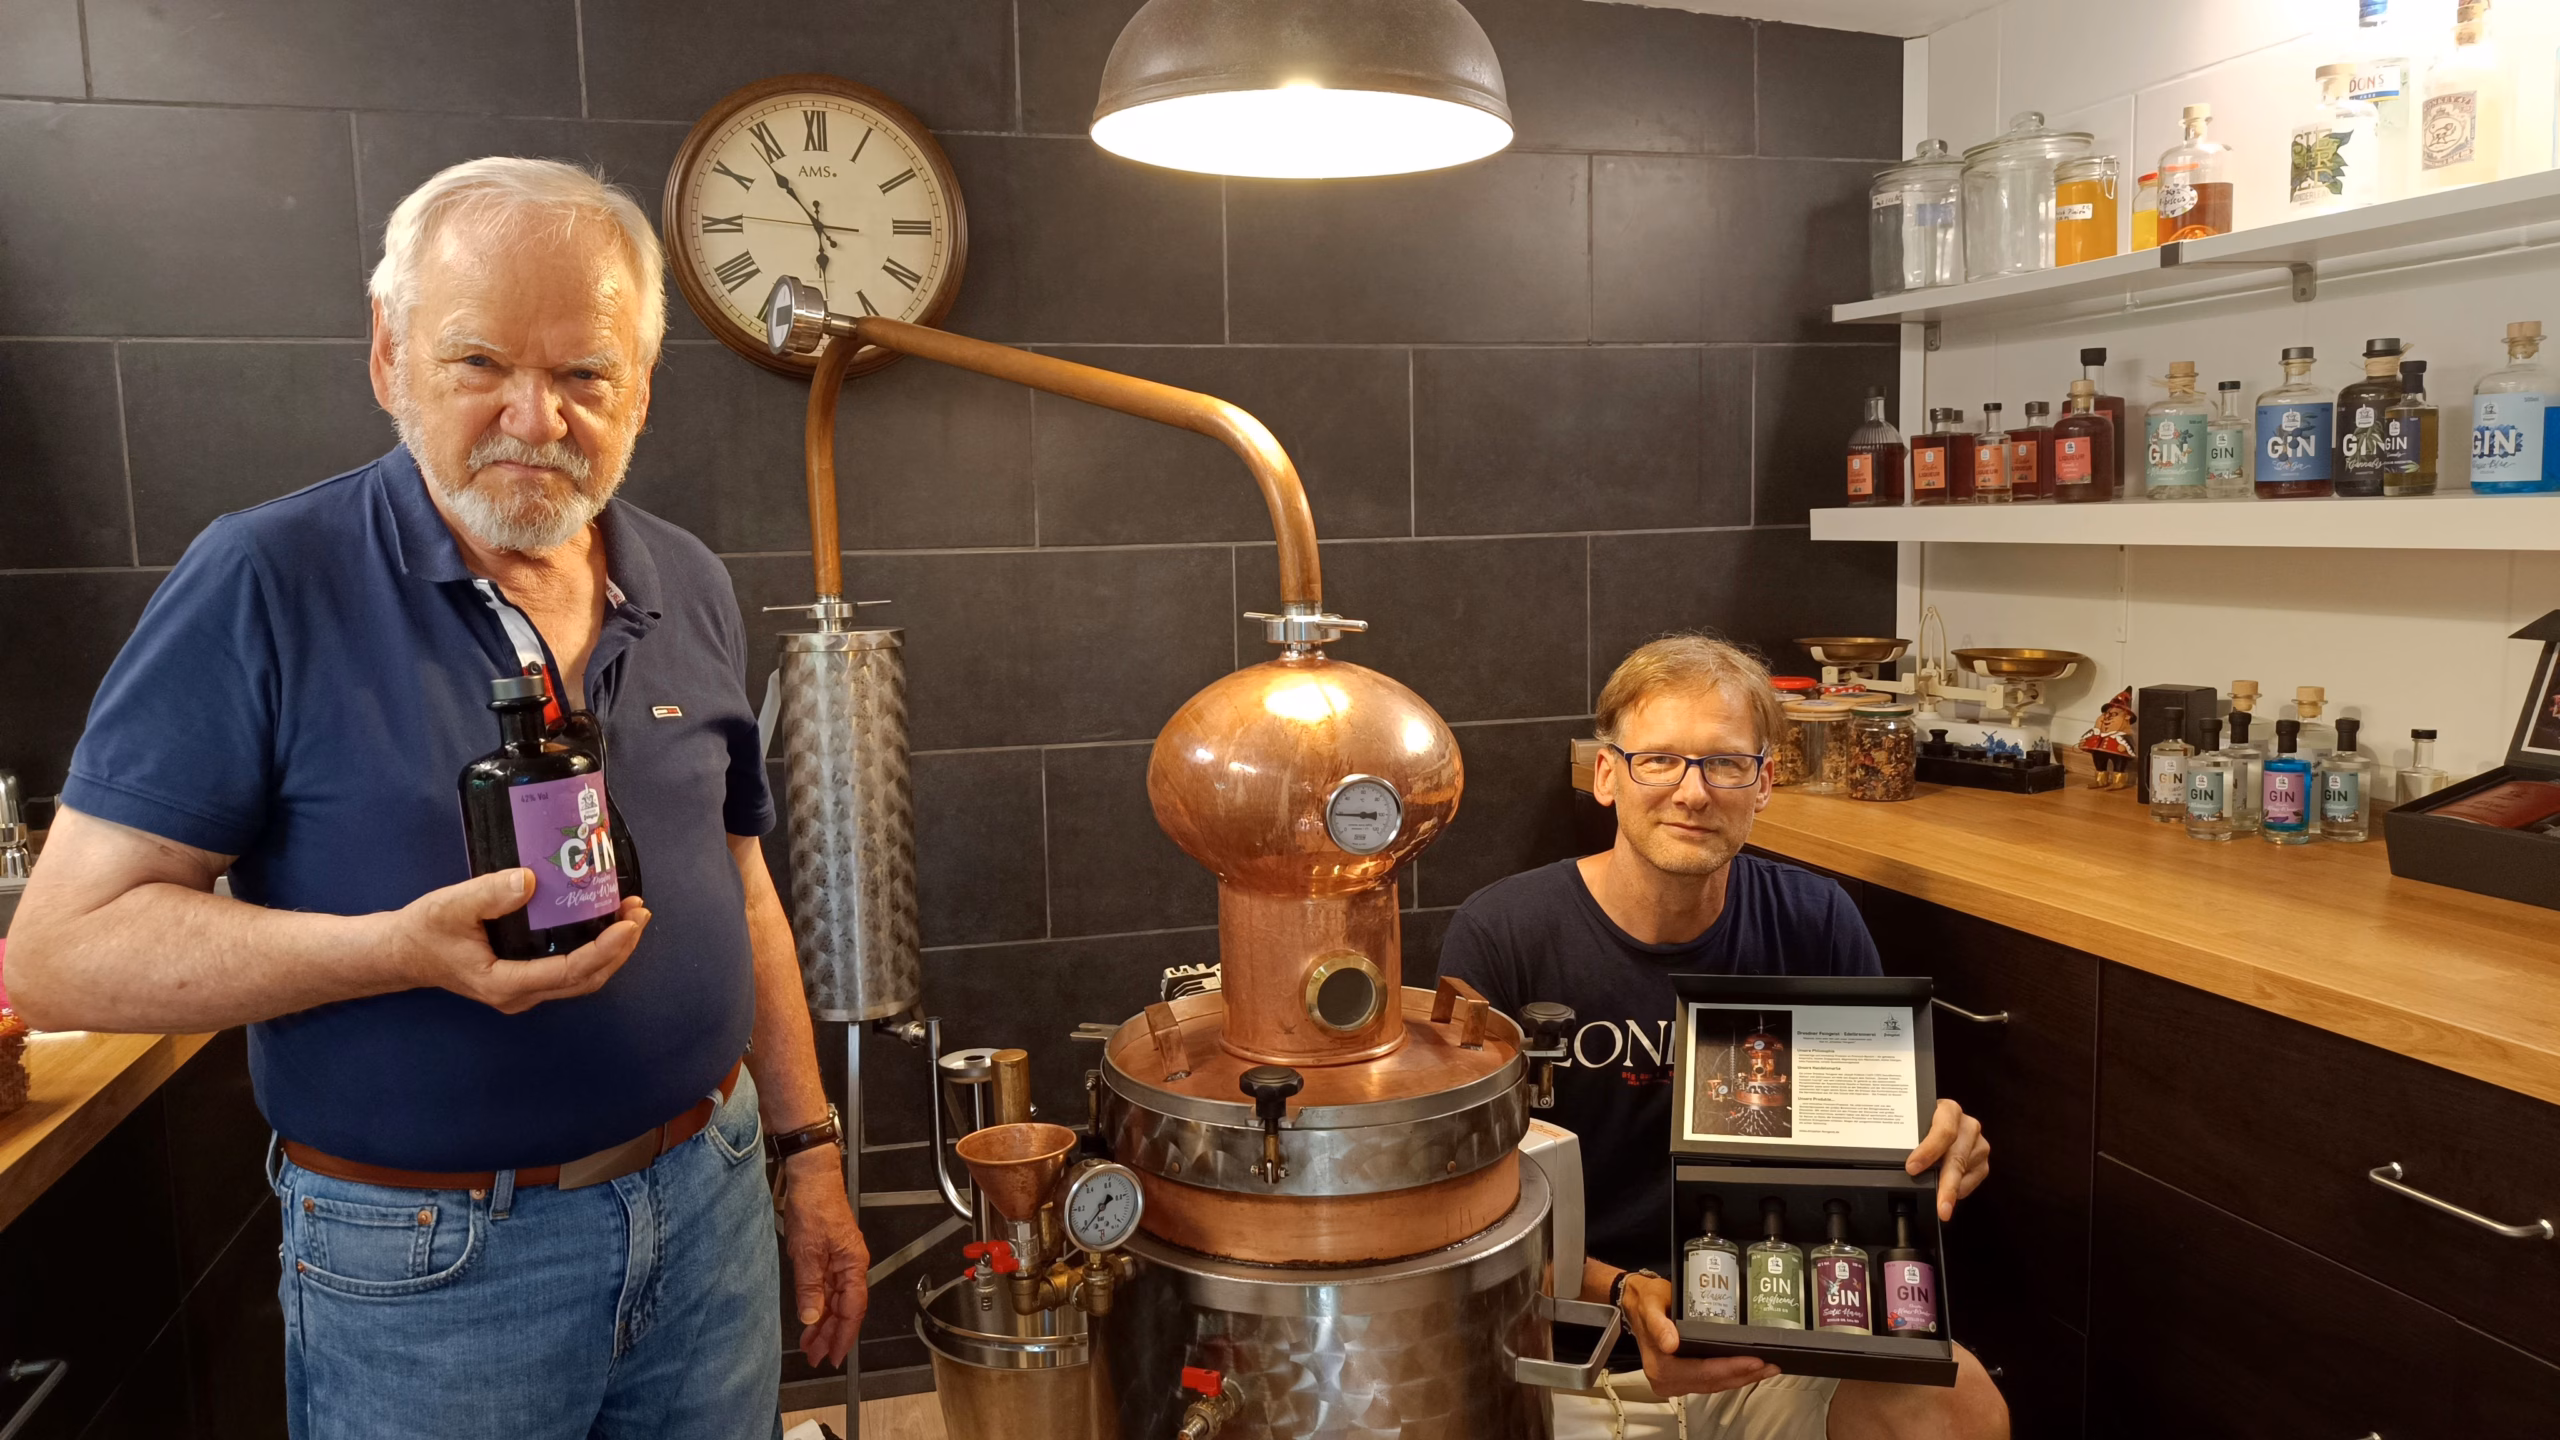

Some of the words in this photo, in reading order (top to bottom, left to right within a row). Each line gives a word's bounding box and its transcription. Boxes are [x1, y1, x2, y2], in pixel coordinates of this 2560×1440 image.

[2267, 435, 2316, 458] GIN
[2342, 433, 2385, 457] GIN
[2385, 436, 2407, 450] GIN
[2473, 429, 2516, 455] GIN
[2149, 444, 2188, 464] GIN
[2211, 447, 2234, 459] GIN
[2190, 788, 2214, 800] GIN
[2269, 790, 2295, 802] GIN
[2324, 789, 2348, 801] GIN
[560, 831, 616, 878] GIN
[1699, 1273, 1729, 1290] GIN
[1760, 1277, 1791, 1295] GIN
[1827, 1289, 1860, 1307] GIN
[1897, 1285, 1929, 1303] GIN
